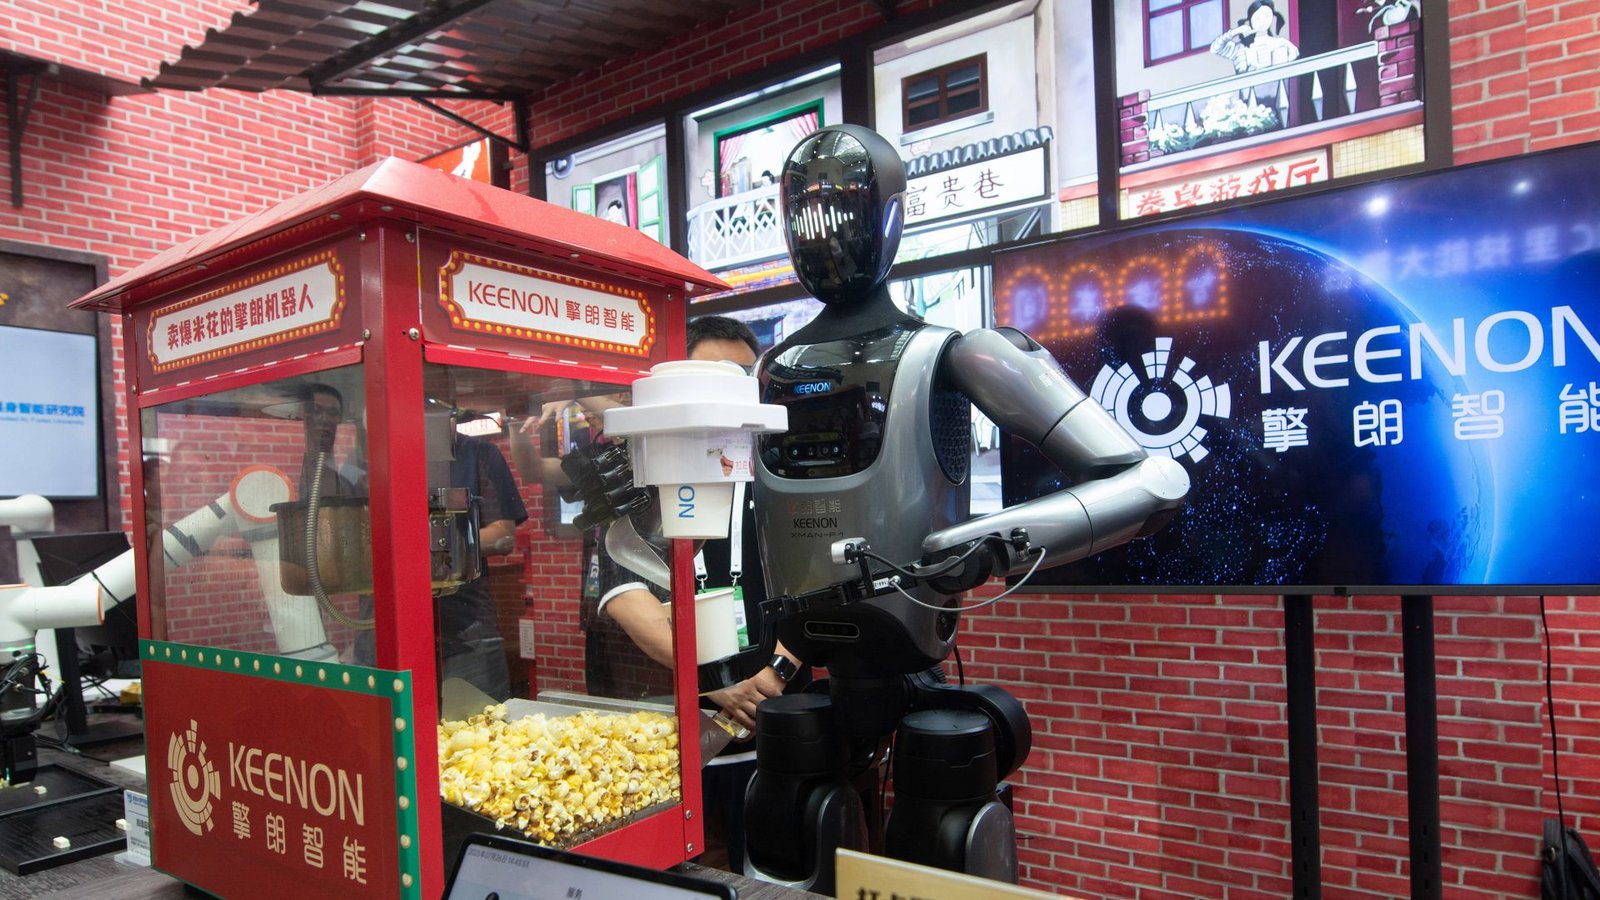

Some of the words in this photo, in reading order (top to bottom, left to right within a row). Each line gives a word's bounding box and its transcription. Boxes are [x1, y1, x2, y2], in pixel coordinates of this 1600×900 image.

[906, 168, 1004, 217] 富贵巷
[167, 283, 314, 350] 卖爆米花的擎朗机器人
[468, 280, 559, 318] KEENON
[566, 299, 635, 332] 擎朗智能
[1258, 305, 1600, 394] KEENON
[0, 401, 85, 417] 身智能研究院
[794, 382, 832, 394] KEENON
[1261, 382, 1600, 453] 擎朗智能
[792, 517, 838, 529] KEENON
[229, 742, 365, 827] KEENON
[232, 800, 367, 885] 擎朗智能
